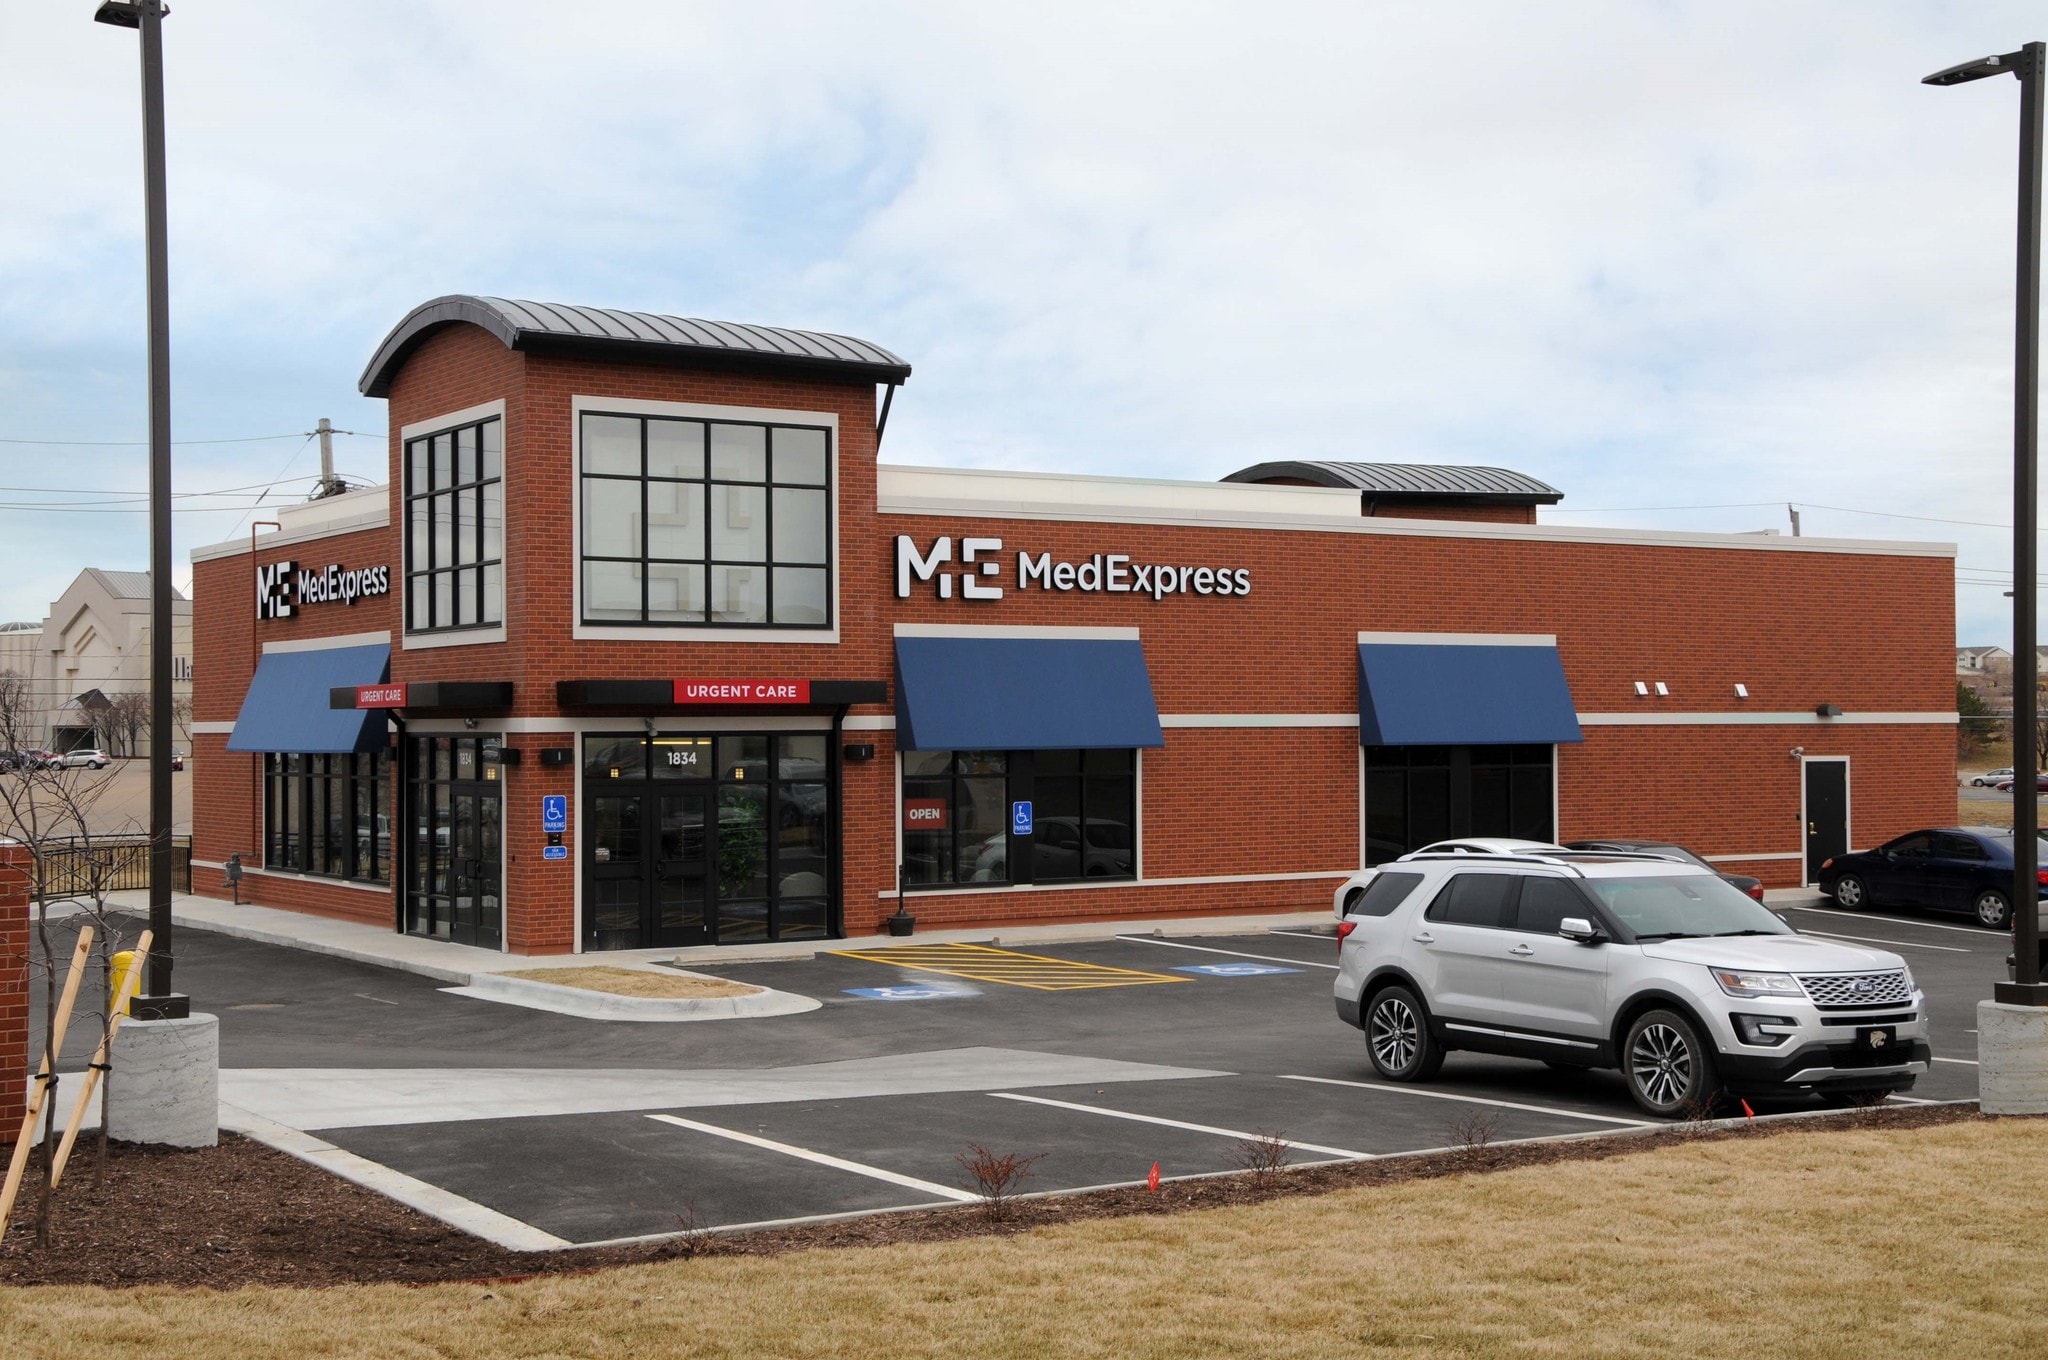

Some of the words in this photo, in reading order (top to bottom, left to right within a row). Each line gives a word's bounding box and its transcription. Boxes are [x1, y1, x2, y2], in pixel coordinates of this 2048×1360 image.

[1019, 551, 1251, 600] MedExpress
[298, 565, 388, 605] MedExpress
[360, 690, 384, 702] URGENT
[385, 689, 402, 701] CARE
[687, 685, 750, 697] URGENT
[755, 685, 797, 697] CARE
[667, 752, 697, 765] 1834
[909, 808, 941, 820] OPEN
